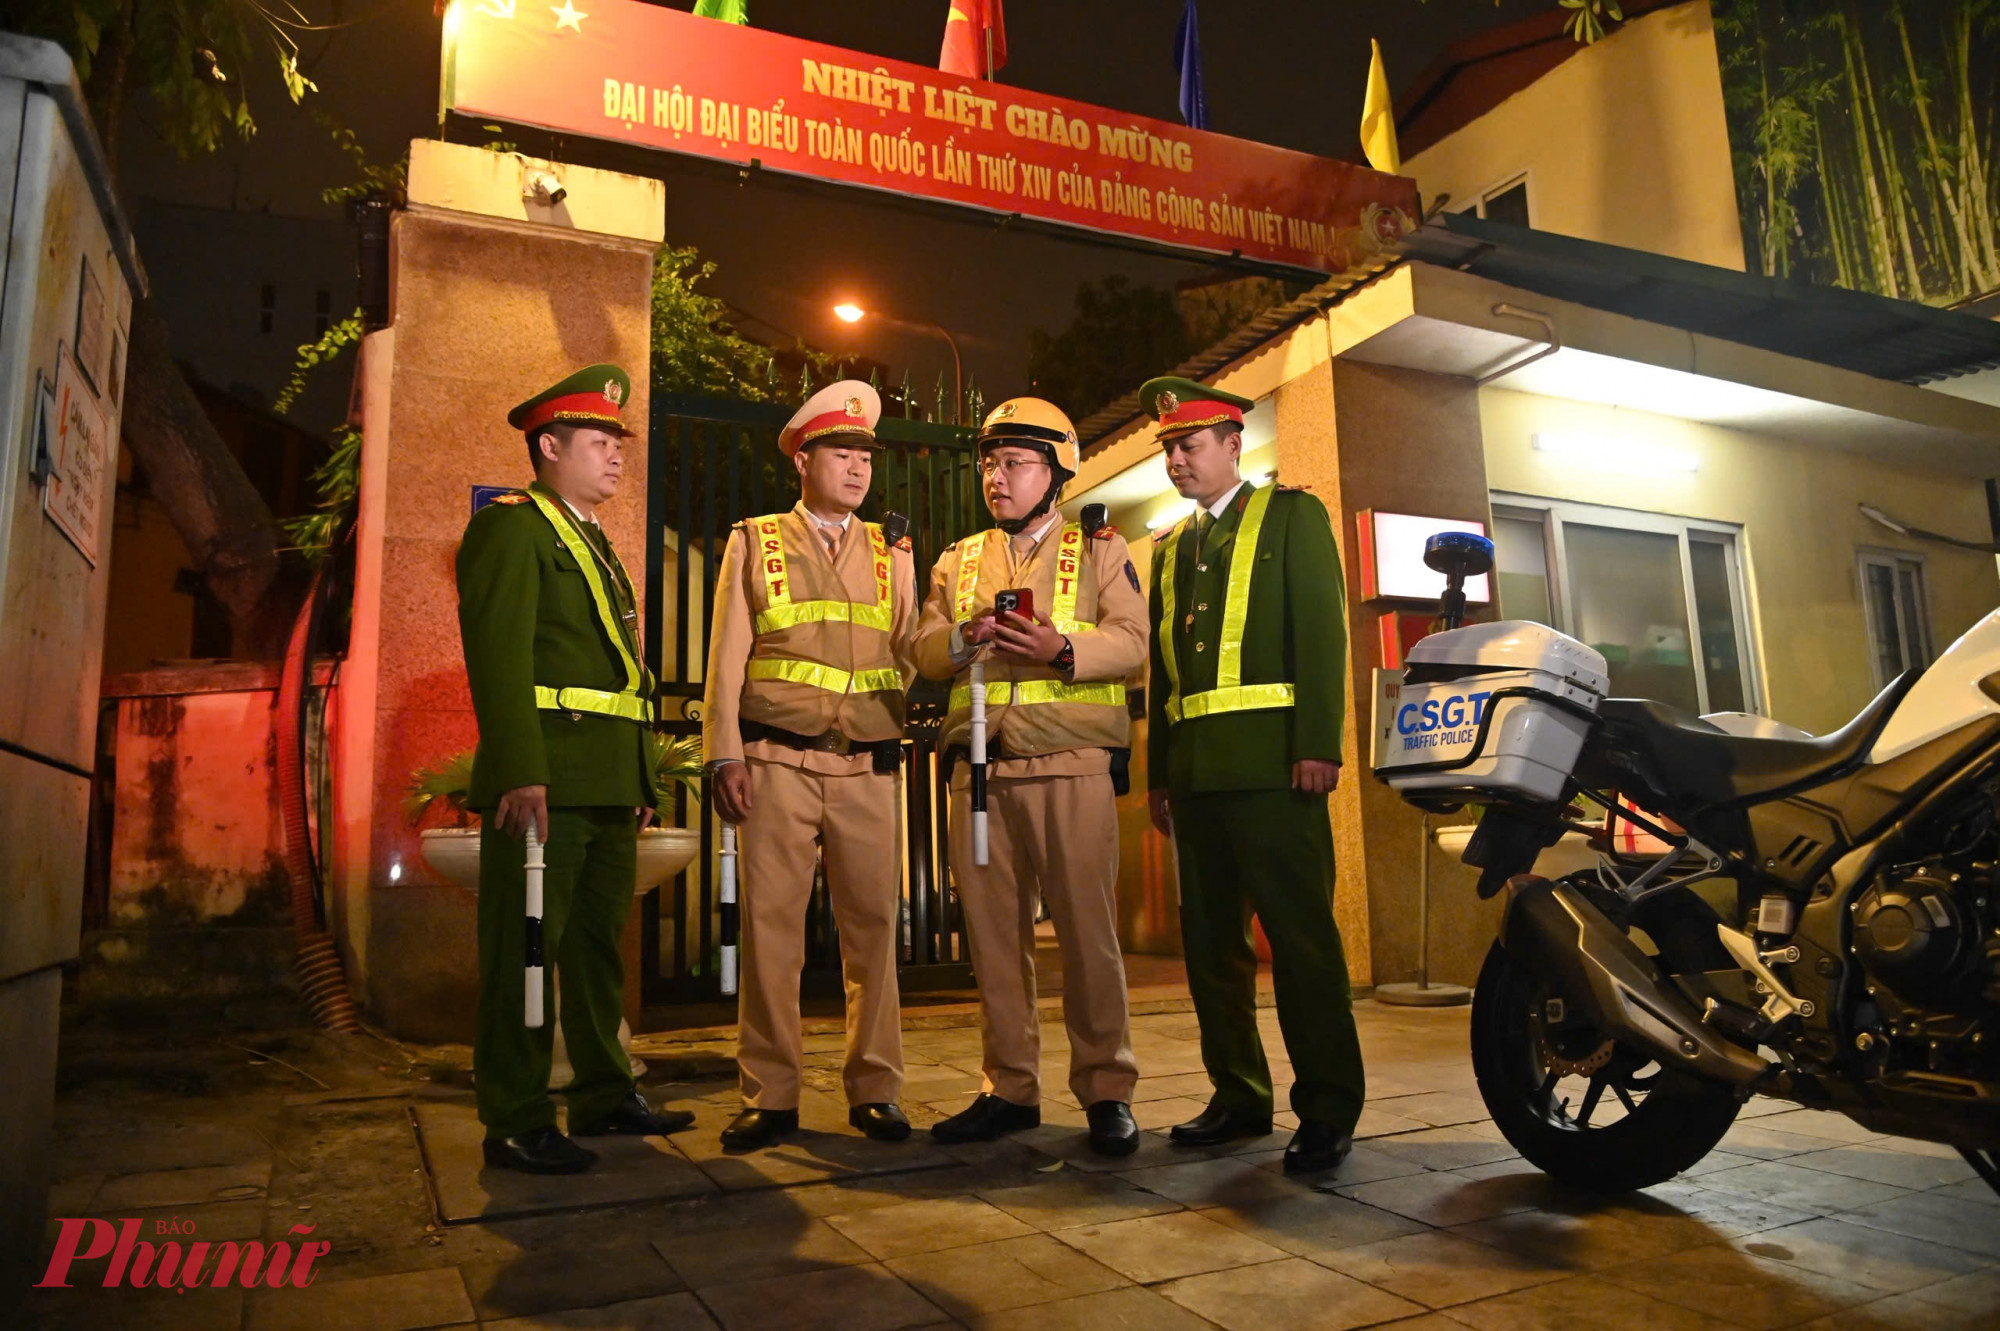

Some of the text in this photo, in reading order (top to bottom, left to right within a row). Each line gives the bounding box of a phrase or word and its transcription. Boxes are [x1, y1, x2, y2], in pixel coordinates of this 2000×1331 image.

[802, 58, 1194, 173] NHIỆT LIỆT CHÀO MỪNG
[603, 78, 645, 129] ĐẠI
[653, 84, 693, 139] HỘI
[700, 98, 740, 148] ĐẠI
[747, 98, 799, 153] BIỂU
[805, 117, 863, 166] TOÀN
[869, 127, 926, 177] QUỐC
[932, 135, 973, 186] LẦN
[977, 152, 1016, 191] THỨ
[1020, 163, 1052, 201] XIV
[1058, 162, 1096, 211] CỦA
[1101, 171, 1151, 222] ĐẢNG
[1156, 191, 1205, 234] CỘNG
[1210, 194, 1245, 240] SẢN
[1249, 206, 1283, 251] VIỆT
[761, 521, 784, 598] CSGT
[1057, 531, 1078, 596] CSGT
[1397, 691, 1491, 735] C.S.G.T
[1403, 733, 1438, 751] TRAFFIC
[1440, 728, 1474, 746] POLICE
